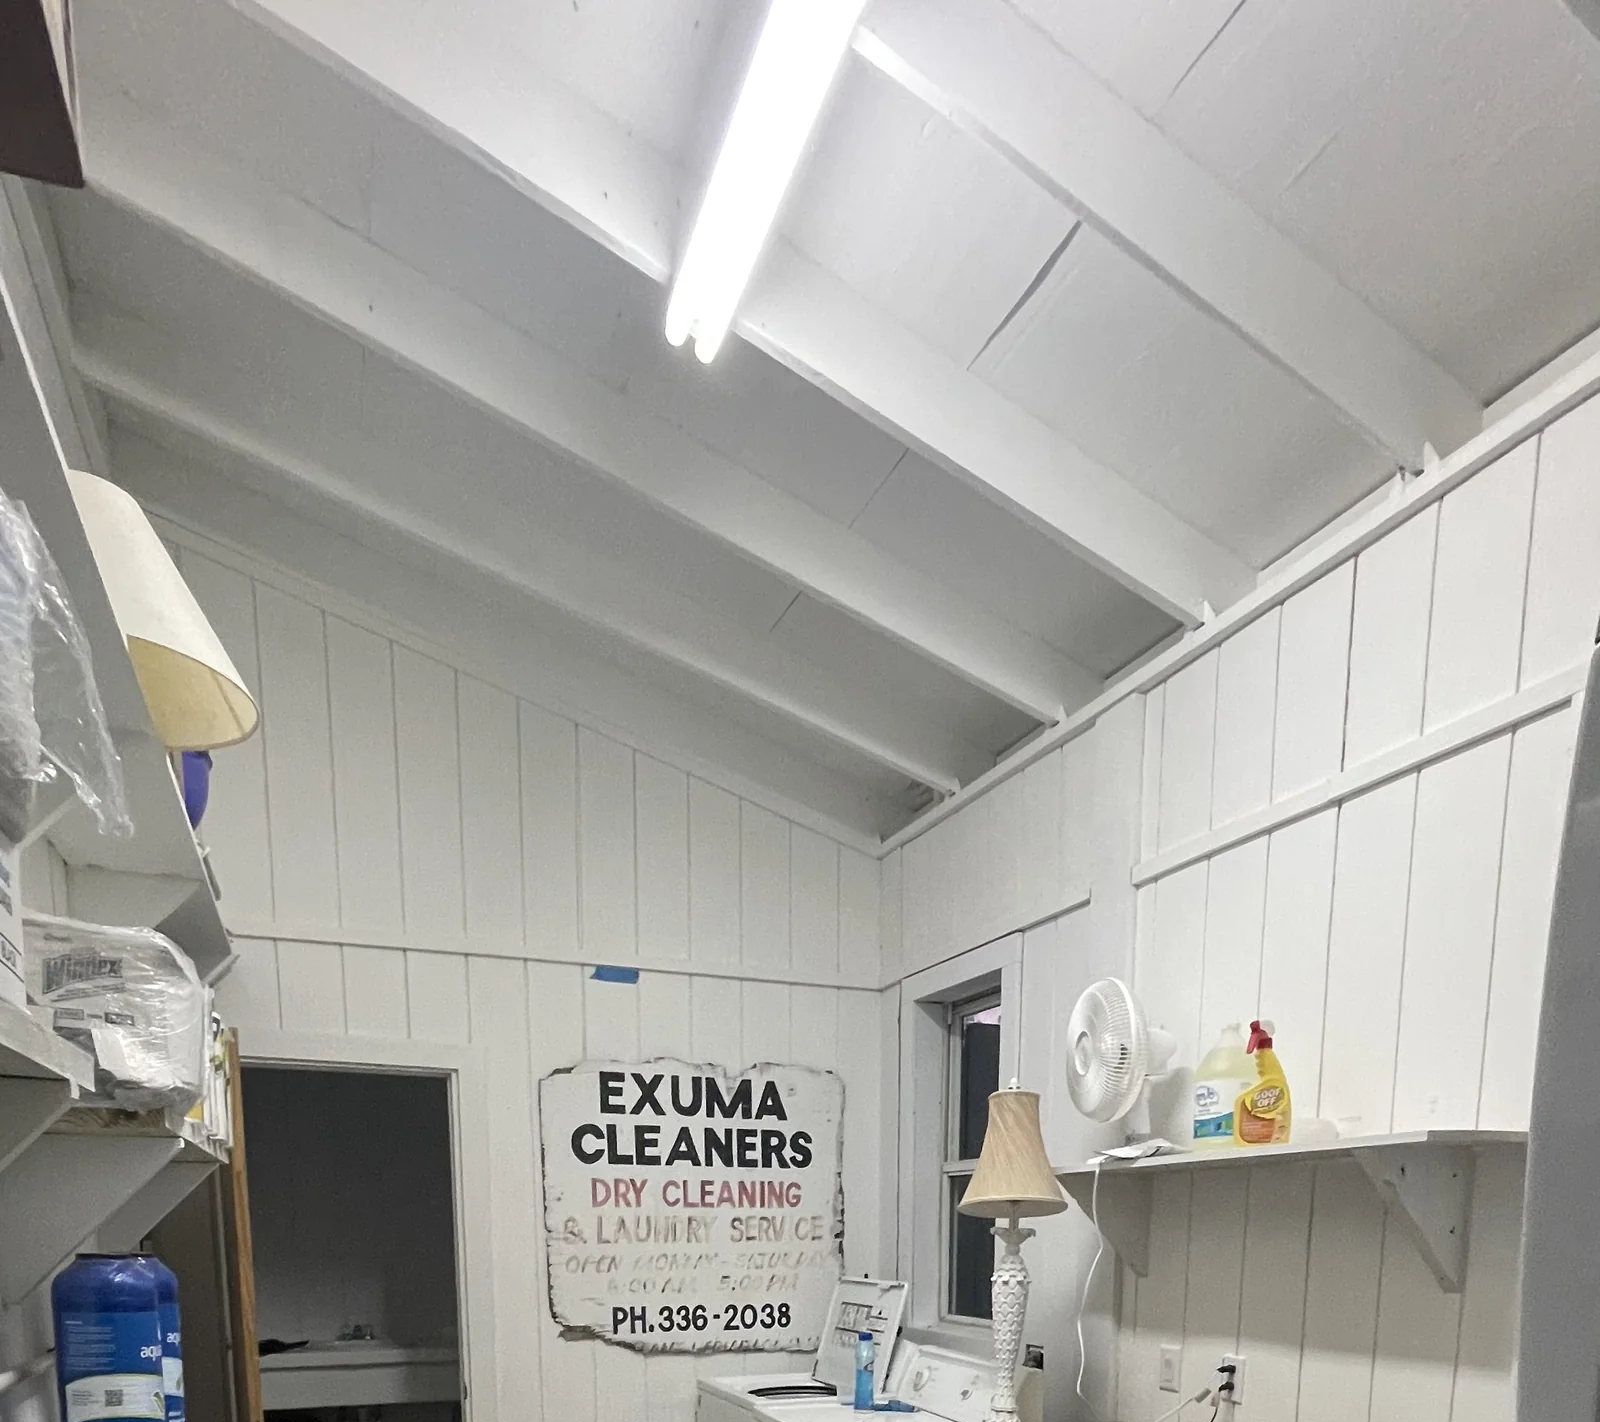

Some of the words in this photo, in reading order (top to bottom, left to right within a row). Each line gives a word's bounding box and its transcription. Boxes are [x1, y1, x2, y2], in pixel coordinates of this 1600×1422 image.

[599, 1071, 788, 1121] EXUMA
[1255, 1088, 1281, 1100] GOOF
[1257, 1097, 1276, 1107] OFF
[571, 1123, 813, 1169] CLEANERS
[591, 1177, 648, 1208] DRY
[662, 1180, 802, 1209] CLEANING
[564, 1216, 587, 1244] &
